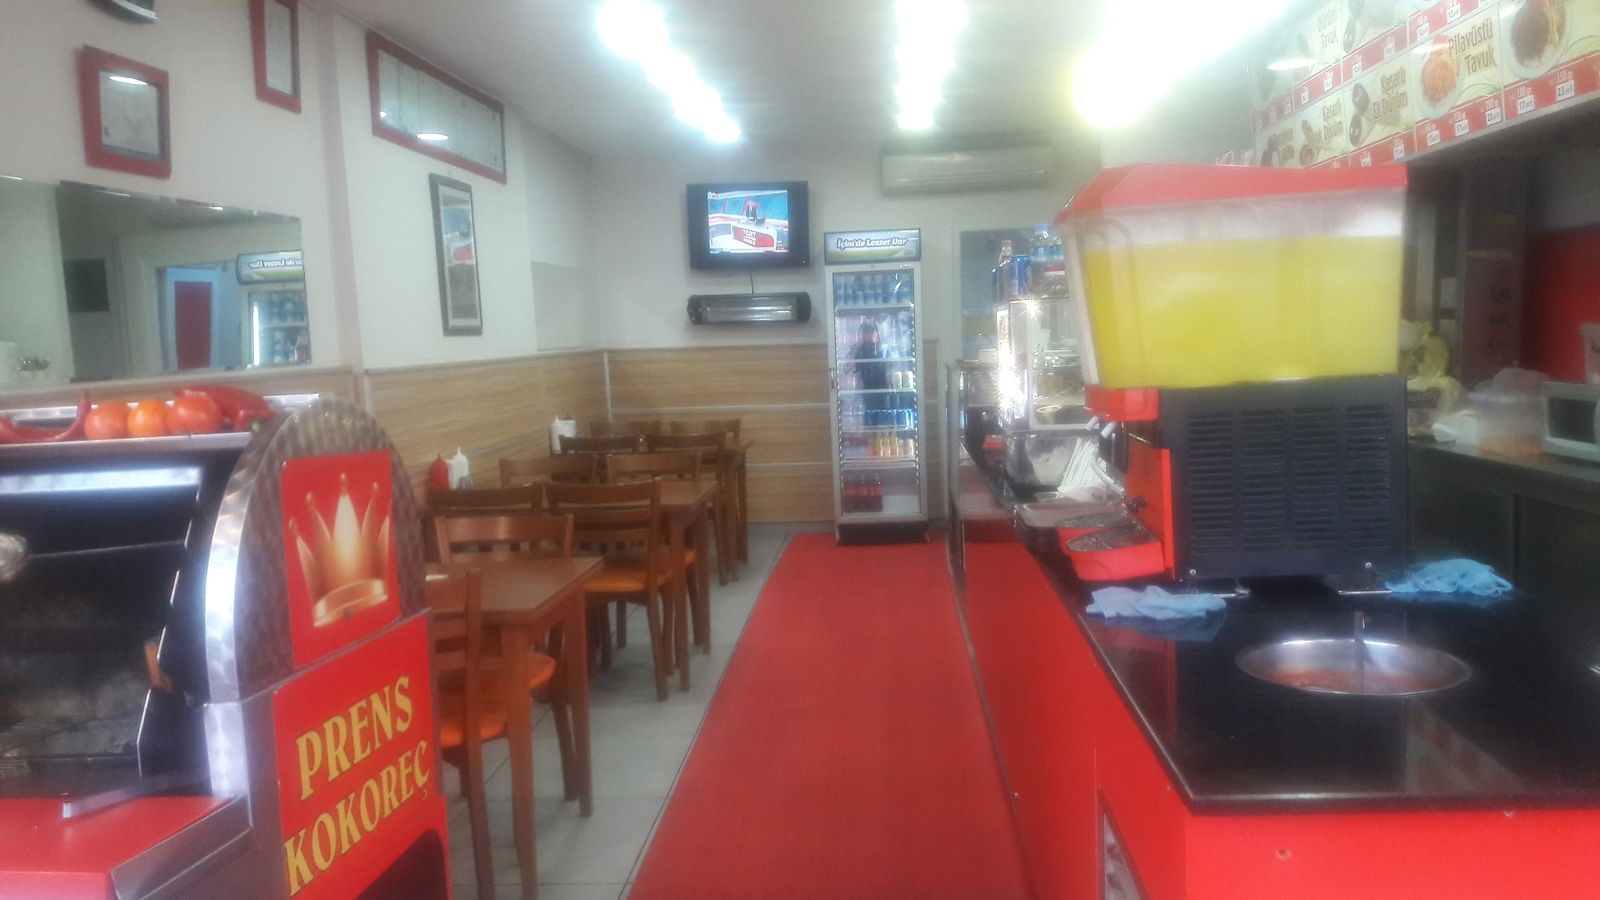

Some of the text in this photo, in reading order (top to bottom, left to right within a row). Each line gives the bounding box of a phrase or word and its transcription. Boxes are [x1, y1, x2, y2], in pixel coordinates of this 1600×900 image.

[1448, 17, 1493, 57] Pilavüstü
[1464, 45, 1497, 75] Tavuk
[866, 238, 890, 248] Lezzet
[891, 236, 908, 247] Var
[296, 676, 413, 801] PRENS
[284, 740, 430, 897] KOKOREÇ
